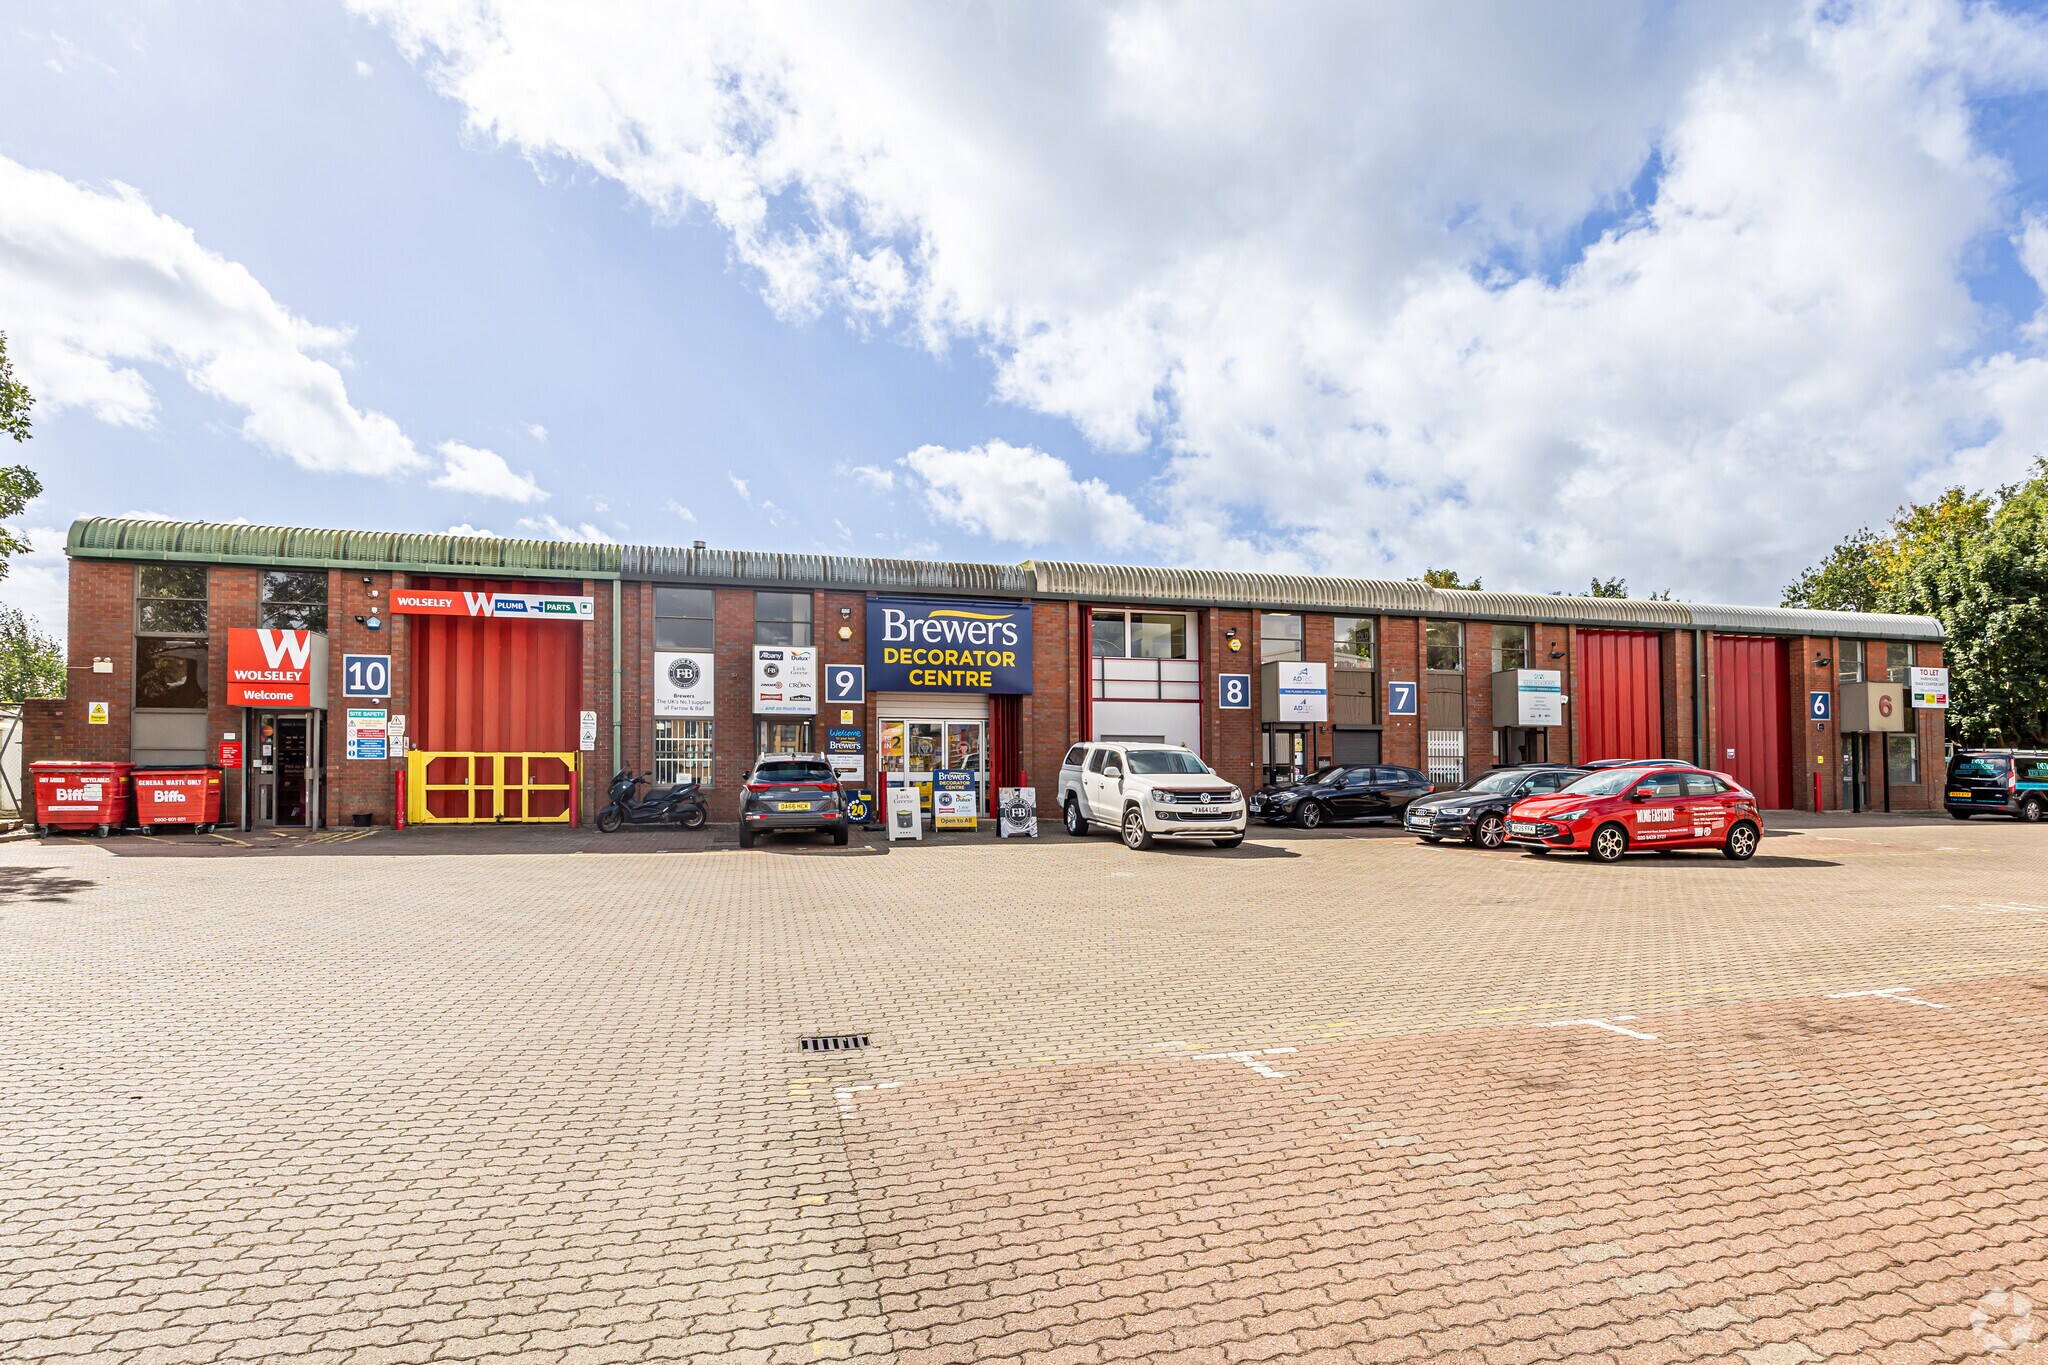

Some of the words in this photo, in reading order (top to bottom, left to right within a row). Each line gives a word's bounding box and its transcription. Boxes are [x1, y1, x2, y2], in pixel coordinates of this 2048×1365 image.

[397, 597, 452, 608] WOLSELEY
[463, 591, 495, 617] W
[497, 602, 524, 610] PLUMB
[546, 603, 571, 612] PARTS
[882, 608, 1018, 646] Brewers
[256, 628, 311, 669] W
[760, 651, 782, 660] Albany
[884, 647, 1016, 667] DECORATOR
[234, 670, 302, 681] WOLSELEY
[348, 661, 386, 690] 10
[908, 669, 993, 687] CENTRE
[835, 670, 855, 697] 9
[243, 690, 294, 701] Welcome
[1227, 679, 1243, 704] 8
[1394, 687, 1409, 710] 7
[1813, 695, 1825, 716] 6
[1878, 694, 1893, 718] 6
[829, 729, 861, 737] Welcome
[829, 740, 861, 749] Brewers
[939, 772, 971, 780] Brewers
[154, 790, 186, 802] Biffa
[850, 805, 864, 817] 24
